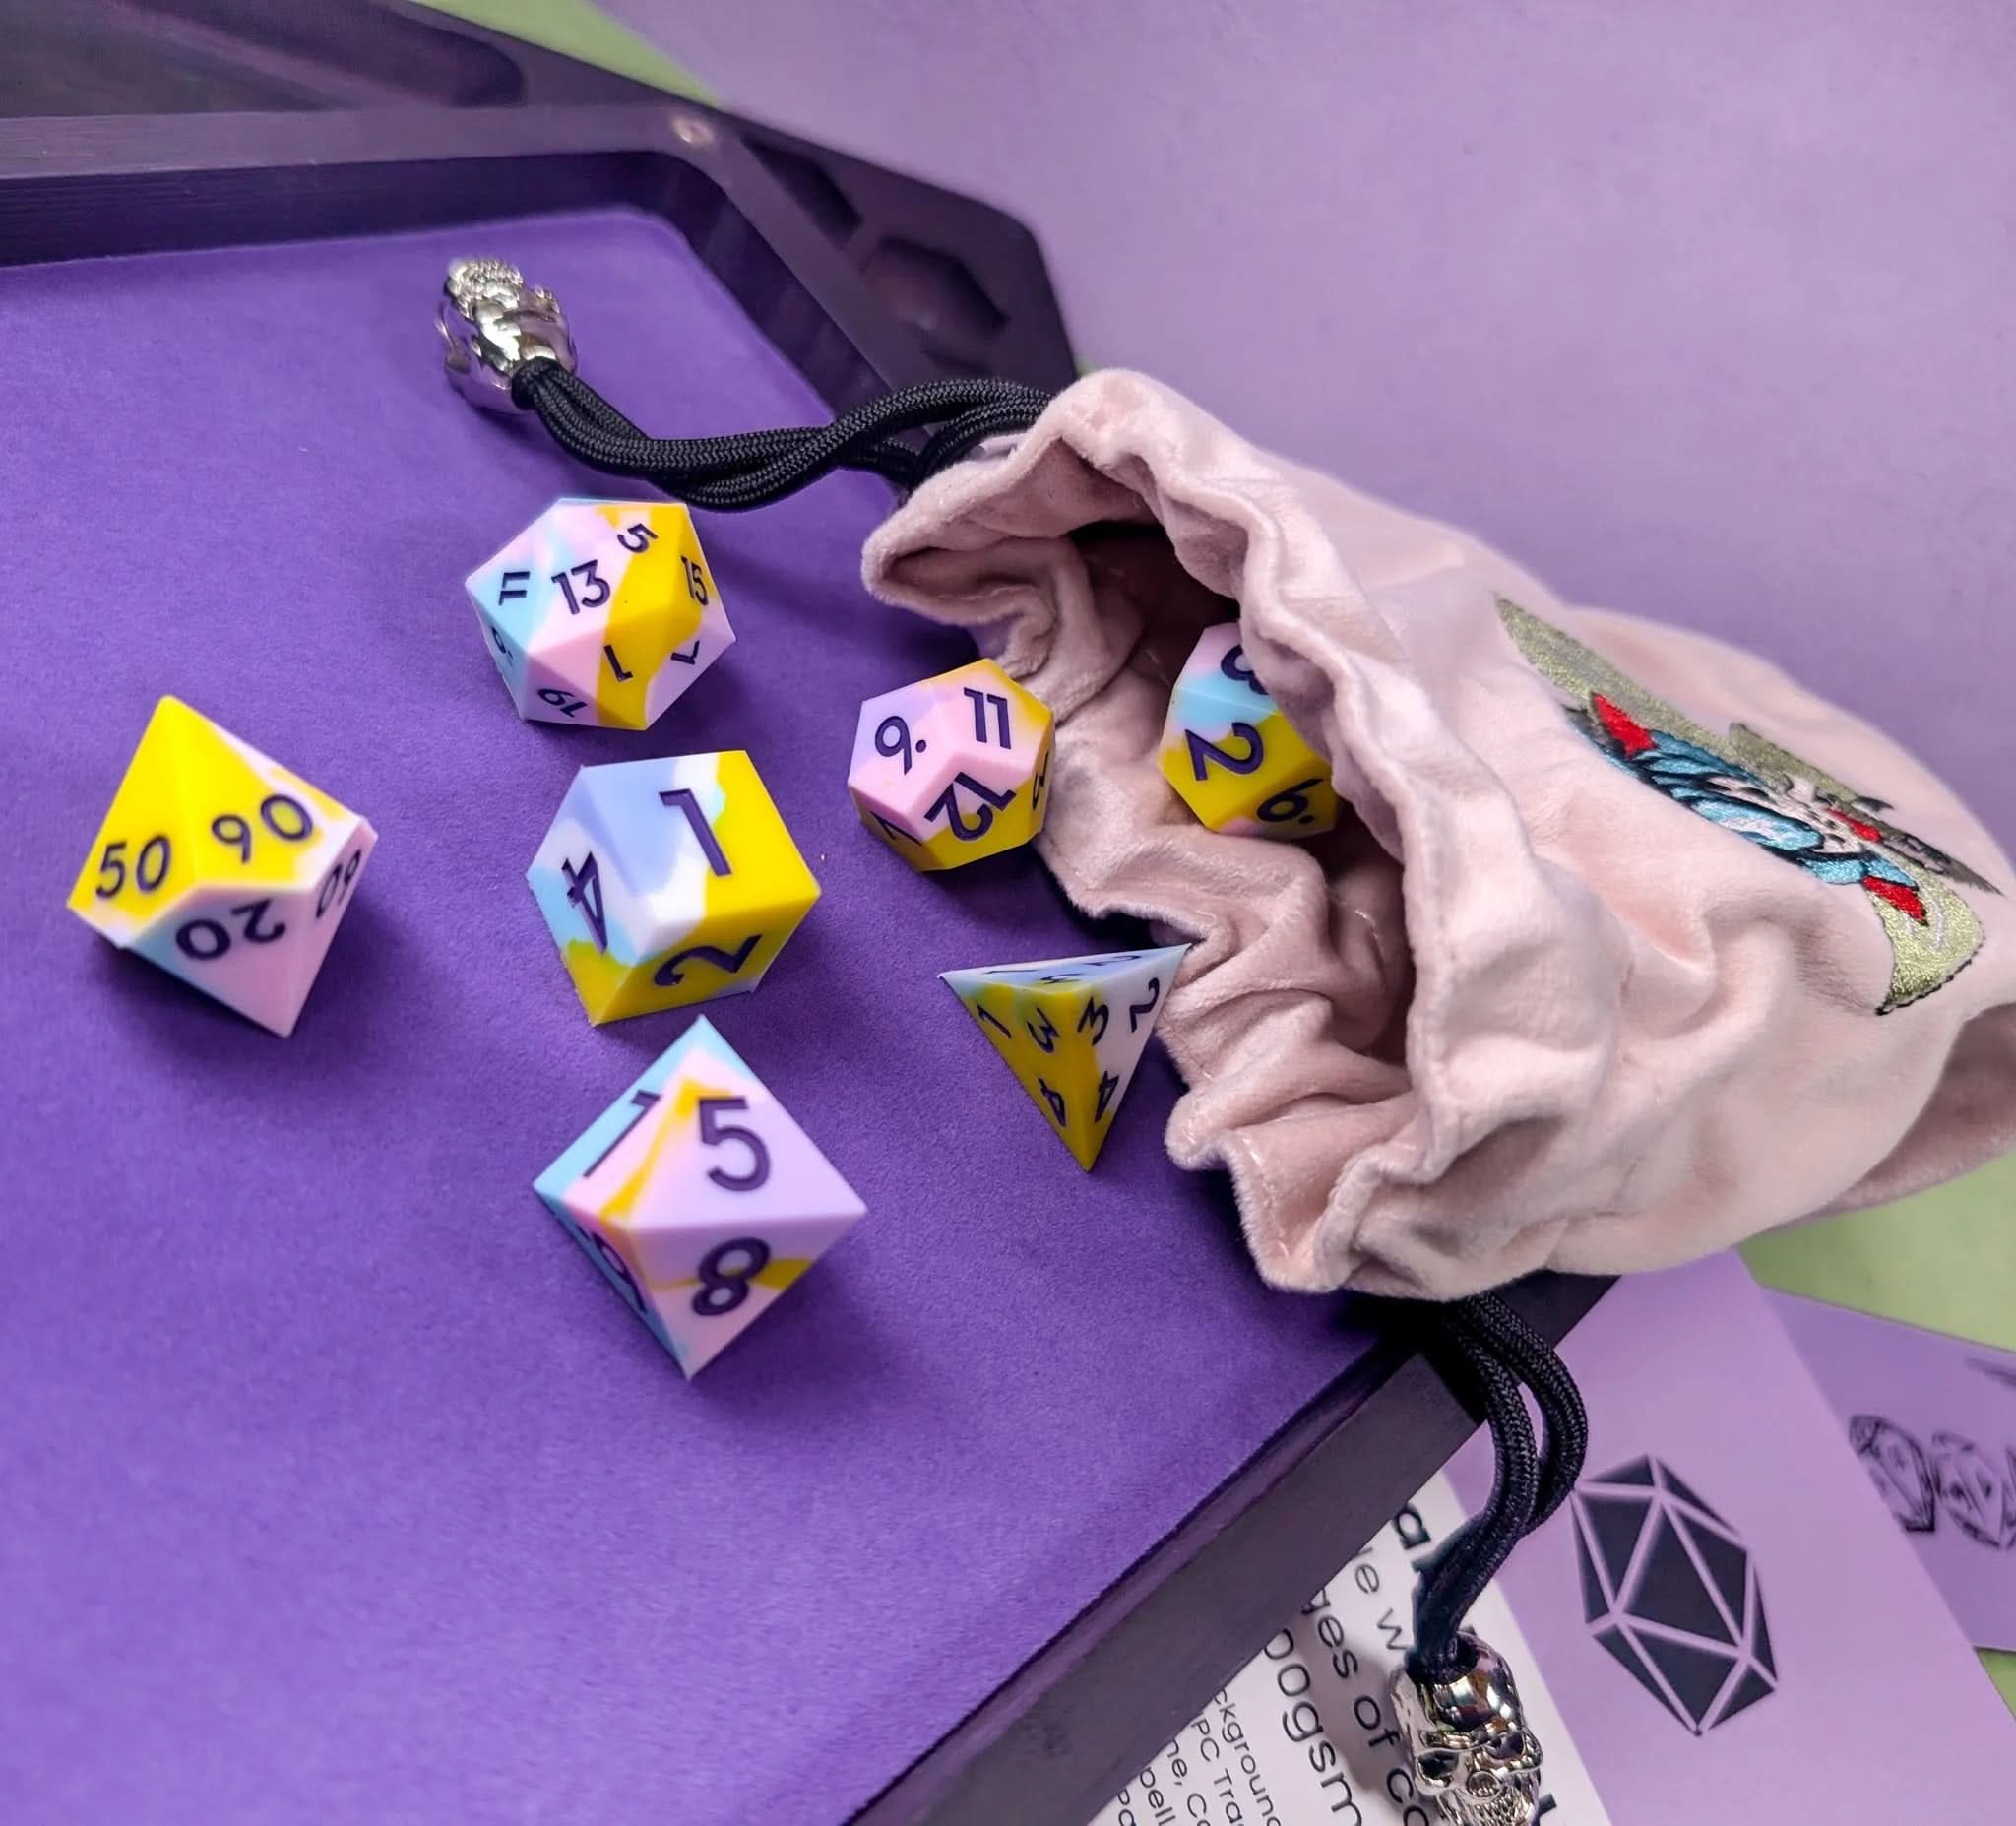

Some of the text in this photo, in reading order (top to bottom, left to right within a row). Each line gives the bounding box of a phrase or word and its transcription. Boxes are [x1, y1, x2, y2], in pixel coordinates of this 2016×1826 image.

[617, 523, 659, 553] 5
[551, 559, 611, 615] 13
[681, 555, 709, 606] 15
[537, 688, 588, 718] 19
[964, 687, 1011, 749] 11
[1184, 722, 1264, 781] 2
[212, 793, 314, 864] 90
[659, 788, 732, 877] 1
[924, 772, 1017, 841] 12
[95, 835, 172, 899] 50
[175, 898, 286, 961] 20
[561, 850, 608, 955] 4
[654, 934, 763, 986] 2
[1027, 1007, 1061, 1054] 3
[1077, 996, 1109, 1047] 3
[1130, 977, 1160, 1034] 2
[698, 1095, 771, 1192] 5
[692, 1237, 771, 1316] 8
[1354, 1695, 1402, 1748] of
